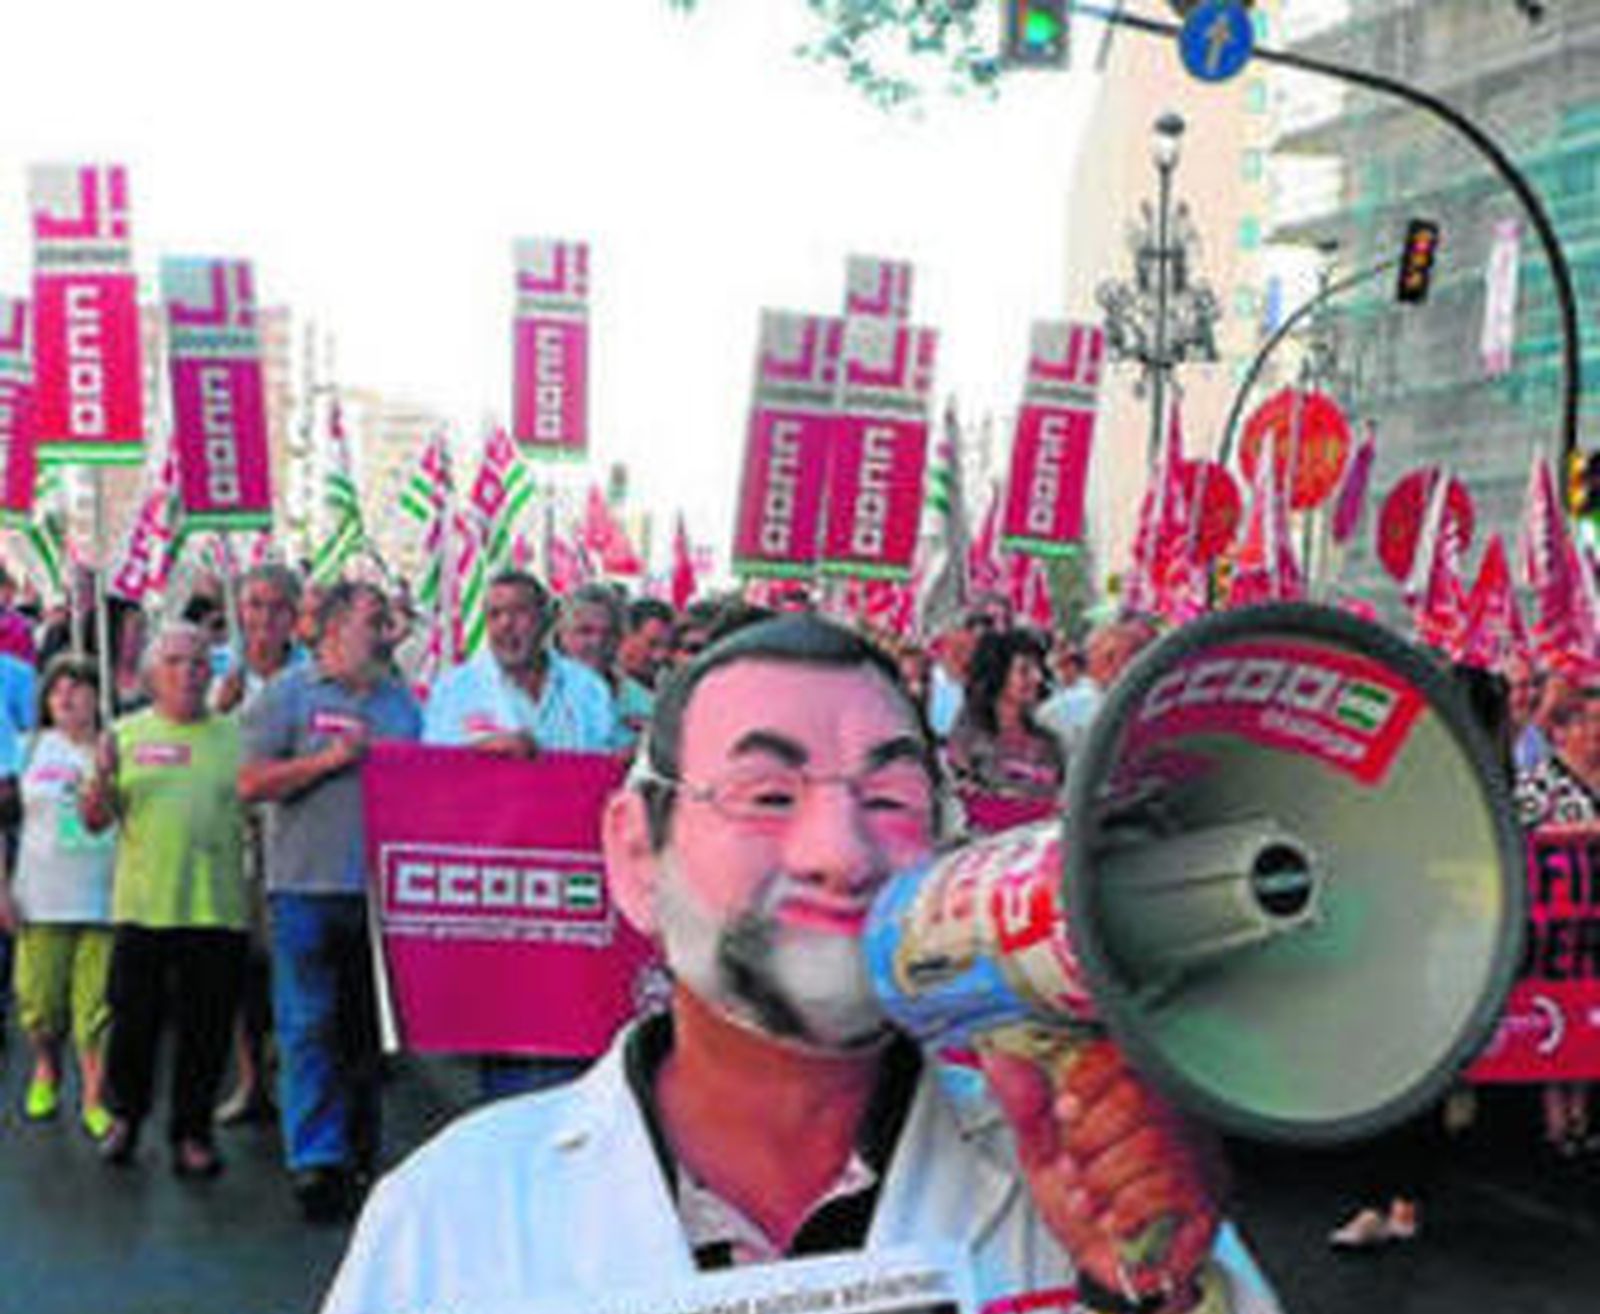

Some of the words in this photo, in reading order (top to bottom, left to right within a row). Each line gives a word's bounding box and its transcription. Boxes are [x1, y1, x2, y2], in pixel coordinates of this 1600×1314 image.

[64, 285, 106, 436] CCOO
[1140, 658, 1342, 723] CCOO
[396, 863, 560, 908] CCOO
